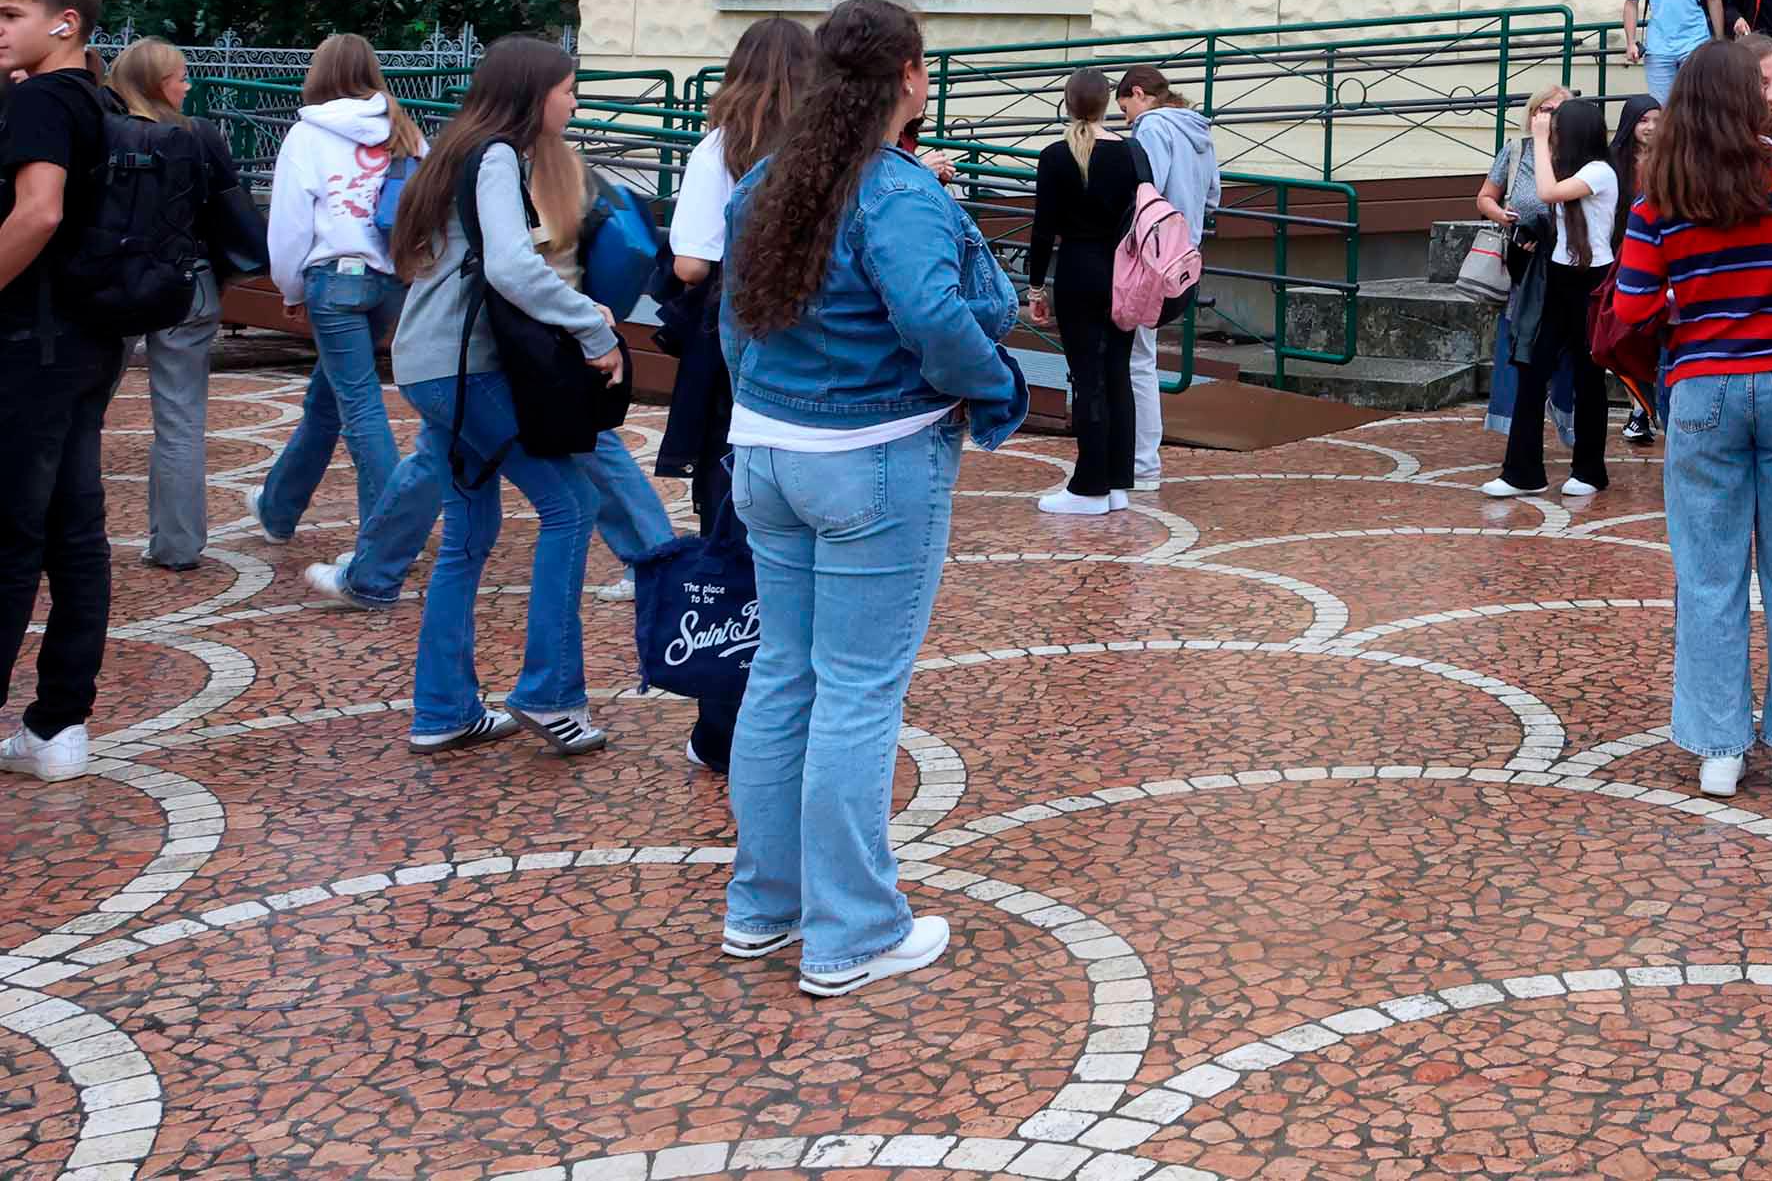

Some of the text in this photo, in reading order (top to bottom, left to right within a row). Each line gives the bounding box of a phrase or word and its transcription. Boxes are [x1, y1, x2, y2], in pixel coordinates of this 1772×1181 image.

[683, 582, 726, 595] The place
[691, 594, 715, 604] to be
[664, 610, 734, 666] Saint
